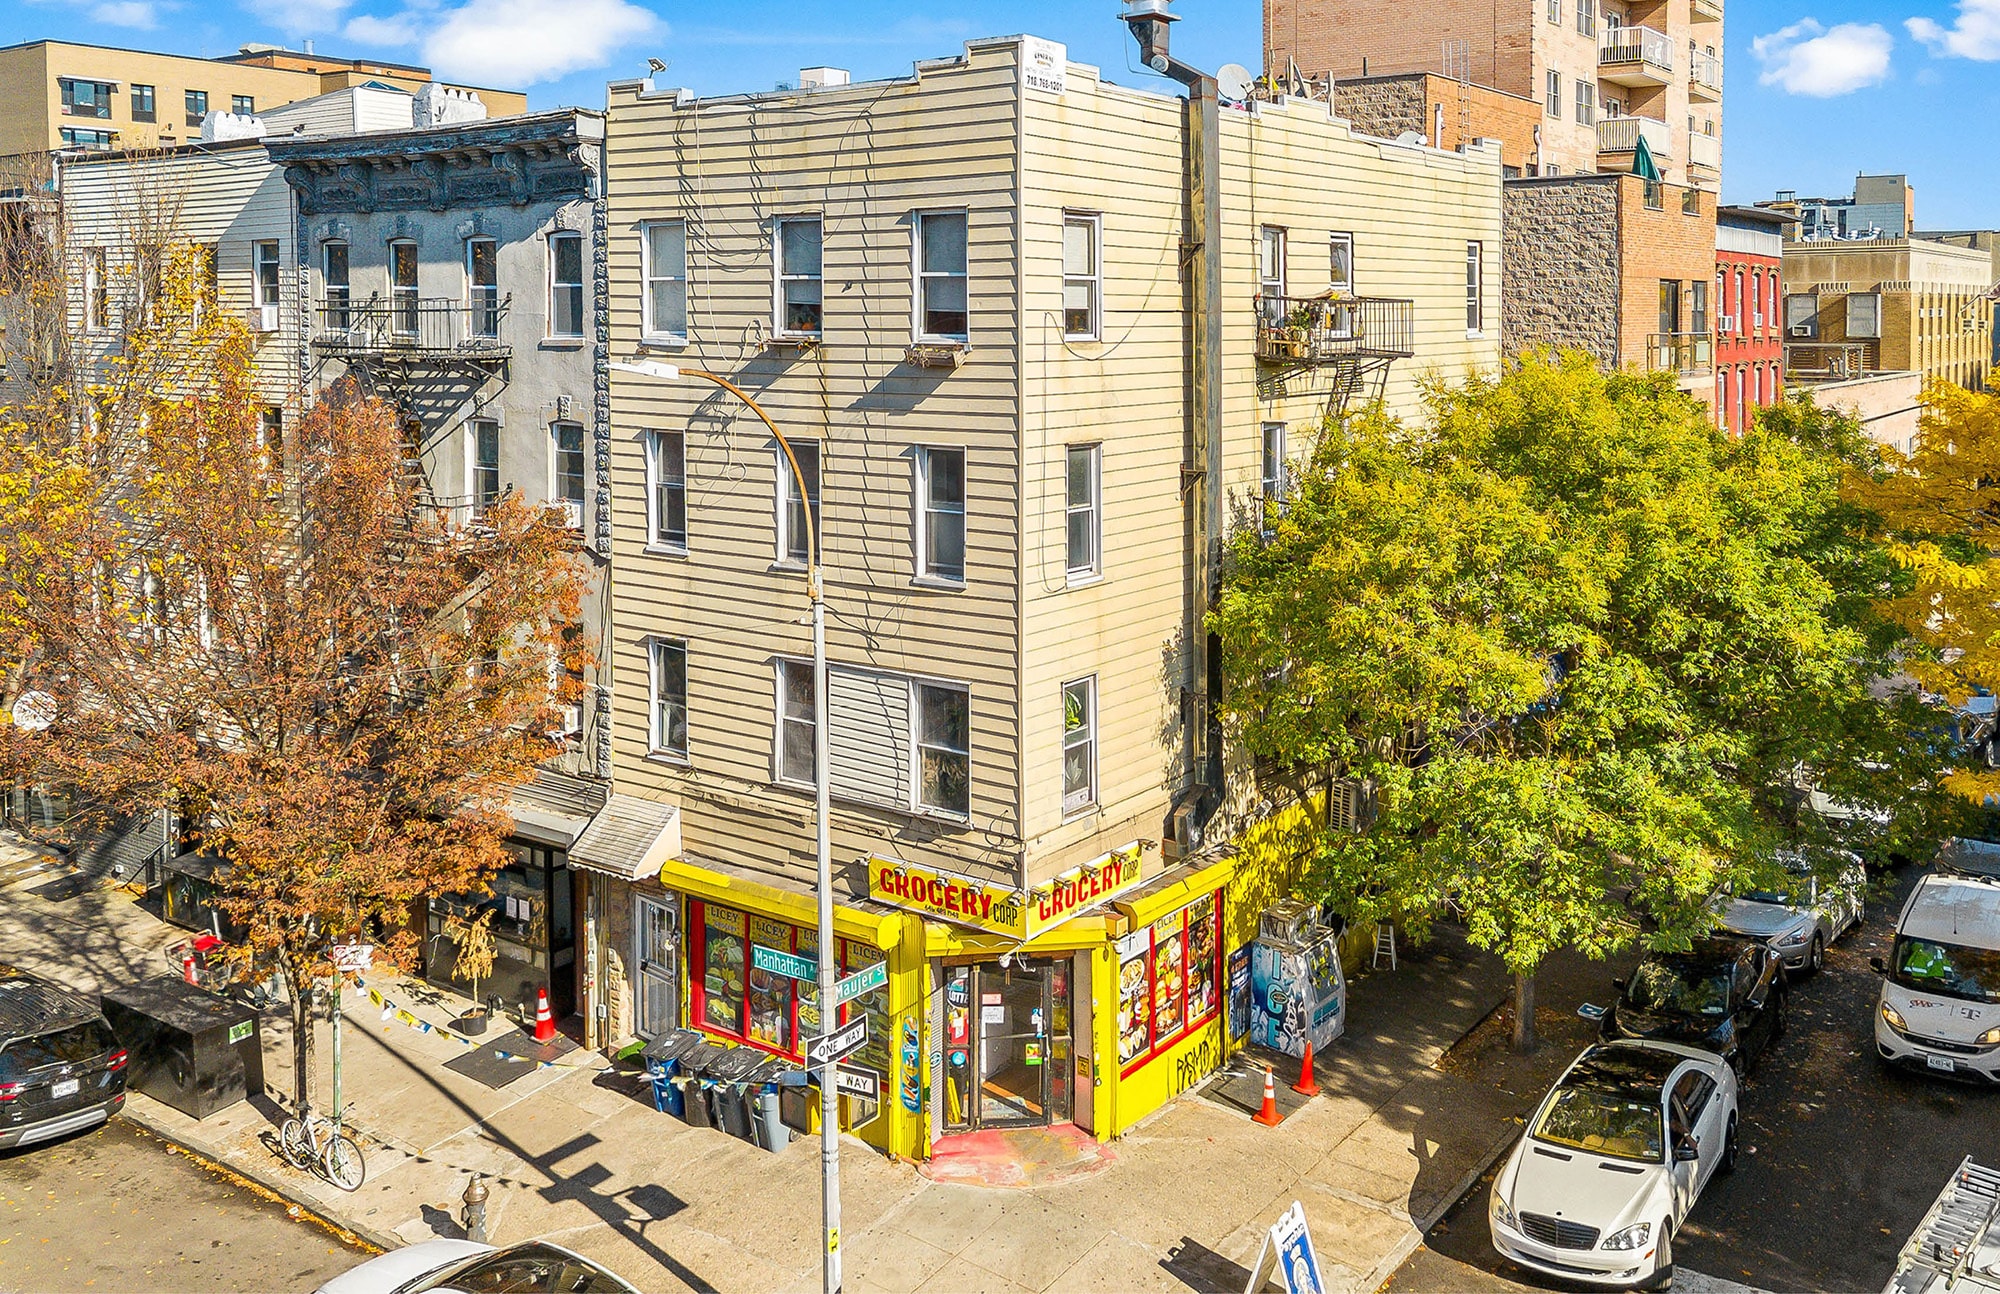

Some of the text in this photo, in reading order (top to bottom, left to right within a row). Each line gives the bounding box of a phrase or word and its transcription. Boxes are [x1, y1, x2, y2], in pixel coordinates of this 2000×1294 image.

[880, 868, 1019, 927] GROCERY CORP.
[1039, 862, 1122, 921] GROCERY
[710, 905, 739, 923] LICEY
[756, 920, 786, 938] LICEY
[804, 930, 818, 943] LIC
[755, 949, 808, 978] Manhattan
[852, 943, 885, 962] LICEY
[836, 971, 874, 999] Maujer
[818, 1040, 838, 1057] ONE
[845, 1027, 861, 1045] WAY
[845, 1074, 868, 1091] WAY
